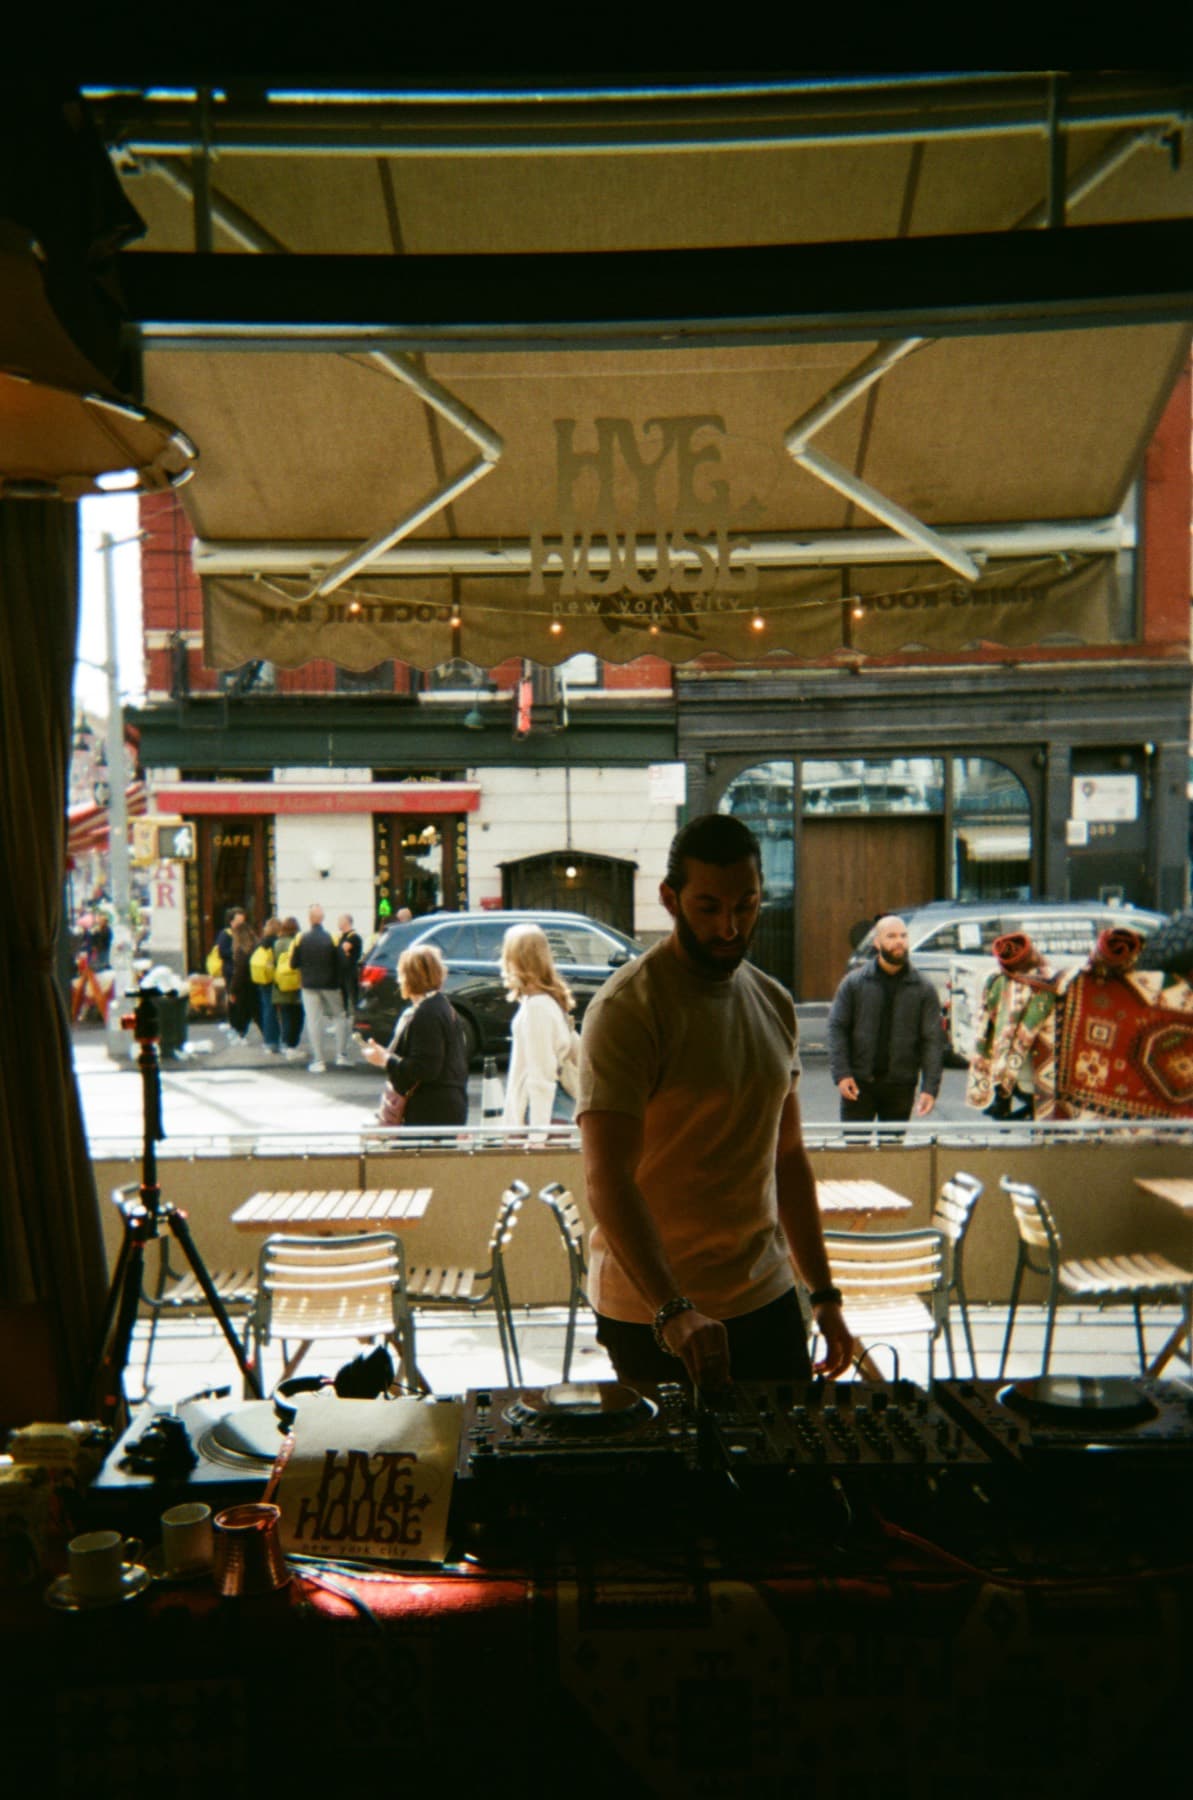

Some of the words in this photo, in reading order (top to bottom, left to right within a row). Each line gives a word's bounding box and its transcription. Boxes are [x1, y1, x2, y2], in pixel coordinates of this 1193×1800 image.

[553, 414, 730, 520] HYE
[527, 516, 760, 595] HOUSE
[553, 601, 600, 613] new
[619, 598, 673, 614] york
[692, 596, 740, 612] city
[319, 1450, 417, 1501] HYE
[294, 1497, 423, 1545] HOUSE
